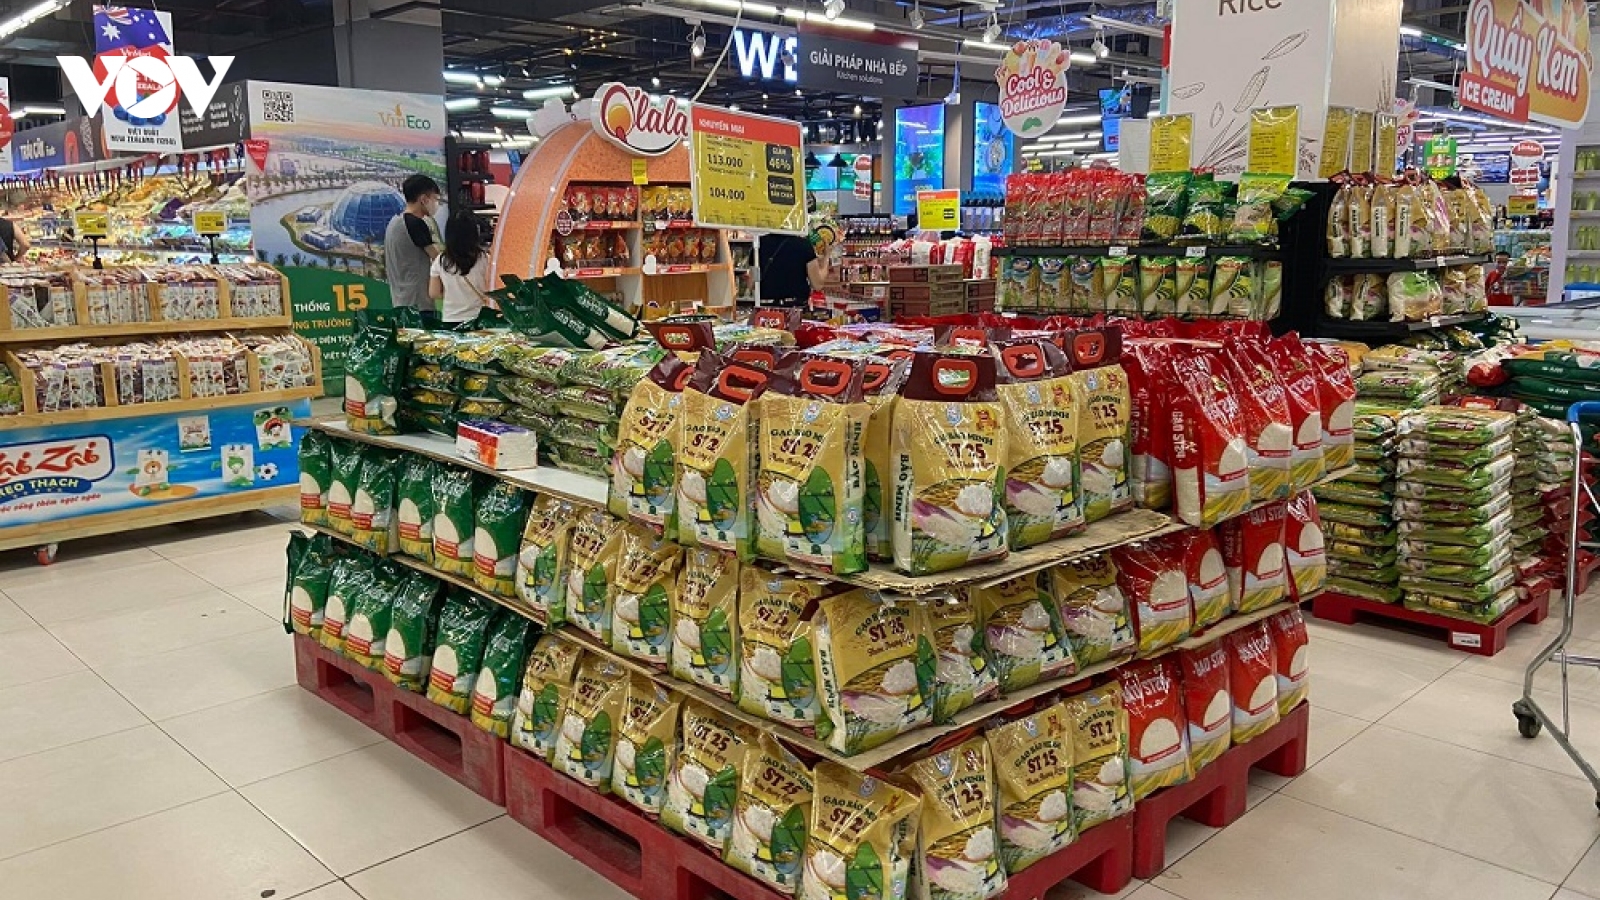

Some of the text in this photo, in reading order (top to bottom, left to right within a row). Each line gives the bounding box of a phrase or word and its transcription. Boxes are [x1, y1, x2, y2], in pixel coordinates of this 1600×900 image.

[810, 47, 908, 77] GIẢI PHÁP NHÀ BẾP
[1537, 27, 1579, 96] Kem
[1007, 67, 1056, 96] Cool &
[1002, 88, 1065, 117] Delicious
[1462, 80, 1516, 115] ICE CREAM
[379, 108, 431, 131] VinEco
[707, 153, 743, 168] 113.000
[332, 284, 369, 311] 15
[35, 441, 100, 472] Zai
[868, 622, 888, 643] ST
[711, 732, 730, 751] 25
[1027, 756, 1042, 774] ST
[762, 766, 804, 795] ST 25
[961, 783, 984, 804] 25
[830, 807, 852, 826] ST
